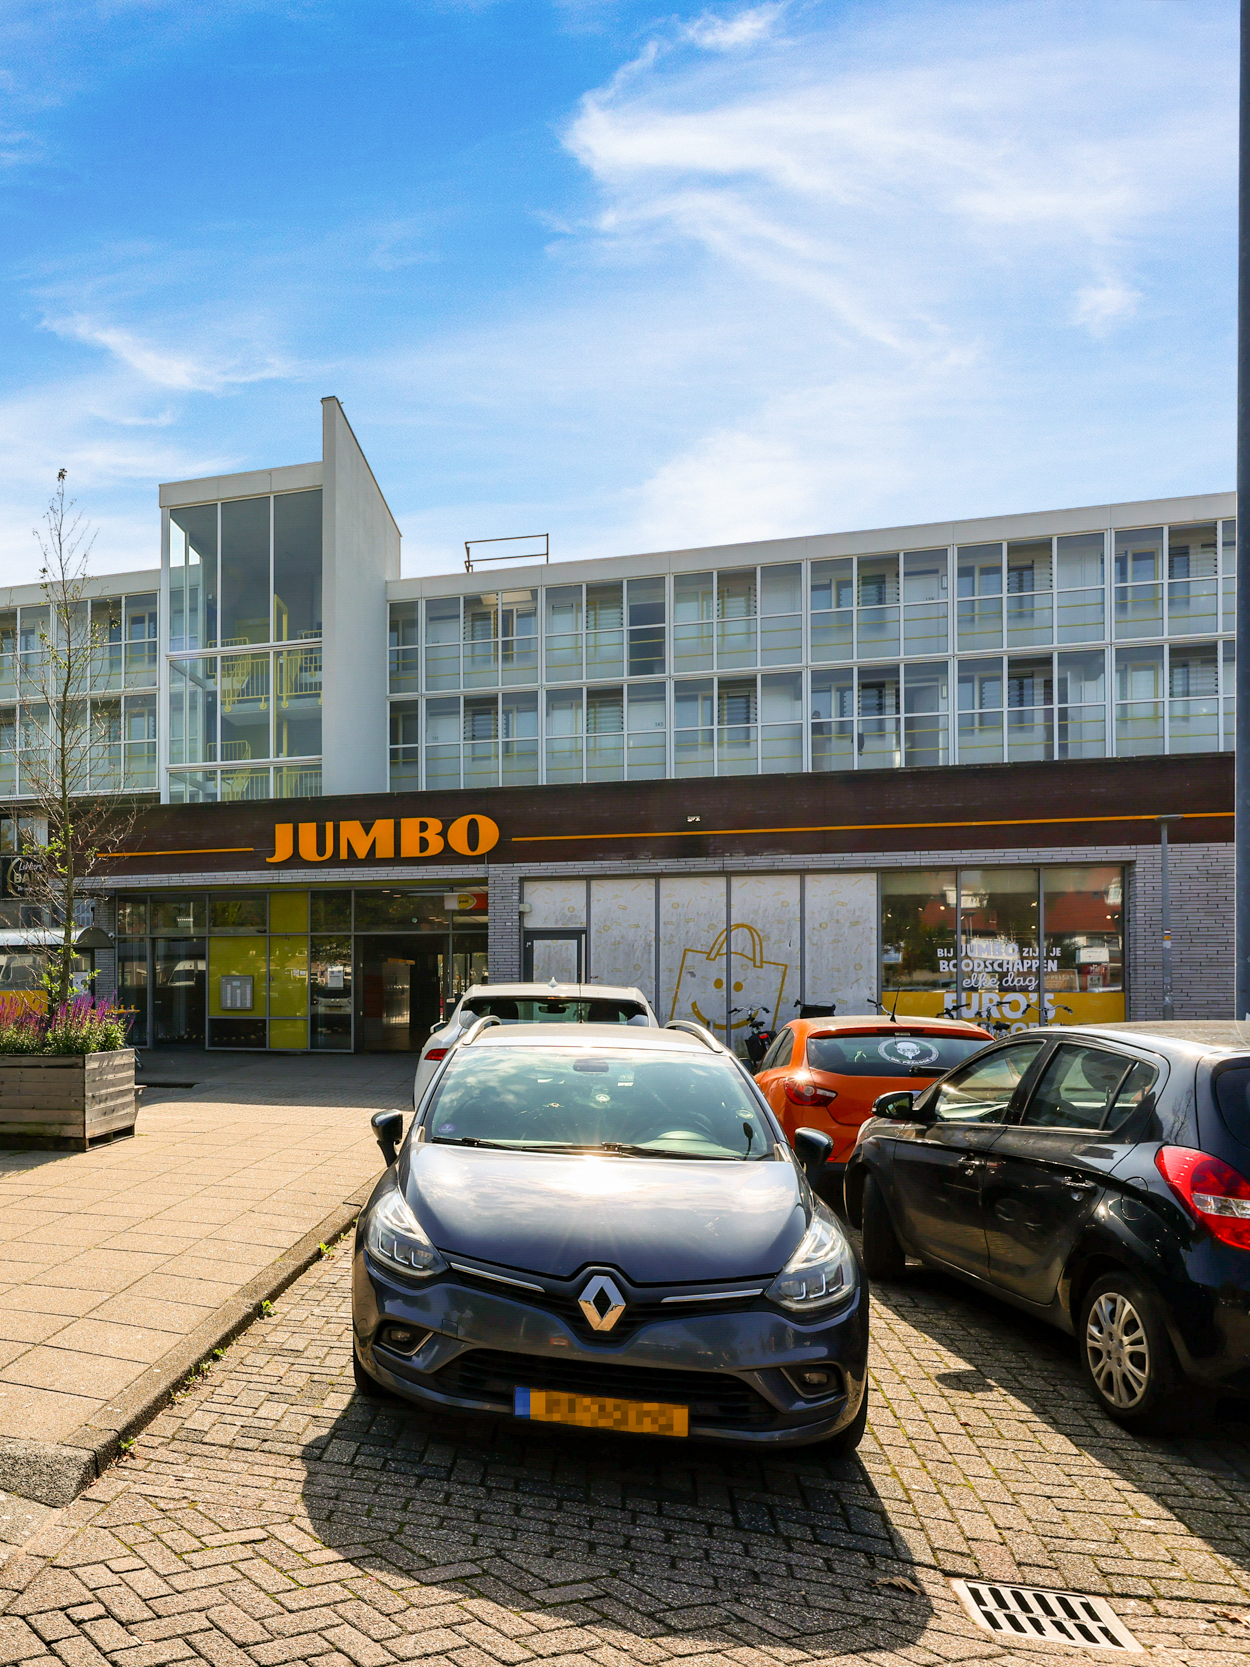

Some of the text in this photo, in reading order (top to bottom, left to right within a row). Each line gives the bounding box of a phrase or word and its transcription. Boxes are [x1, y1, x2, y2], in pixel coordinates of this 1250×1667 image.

[265, 813, 500, 863] JUMBO
[937, 948, 953, 958] BIJ
[960, 943, 1019, 957] JUMBO
[1049, 947, 1062, 957] JE
[962, 971, 1038, 991] elke dag
[943, 992, 1056, 1020] EURO'S
